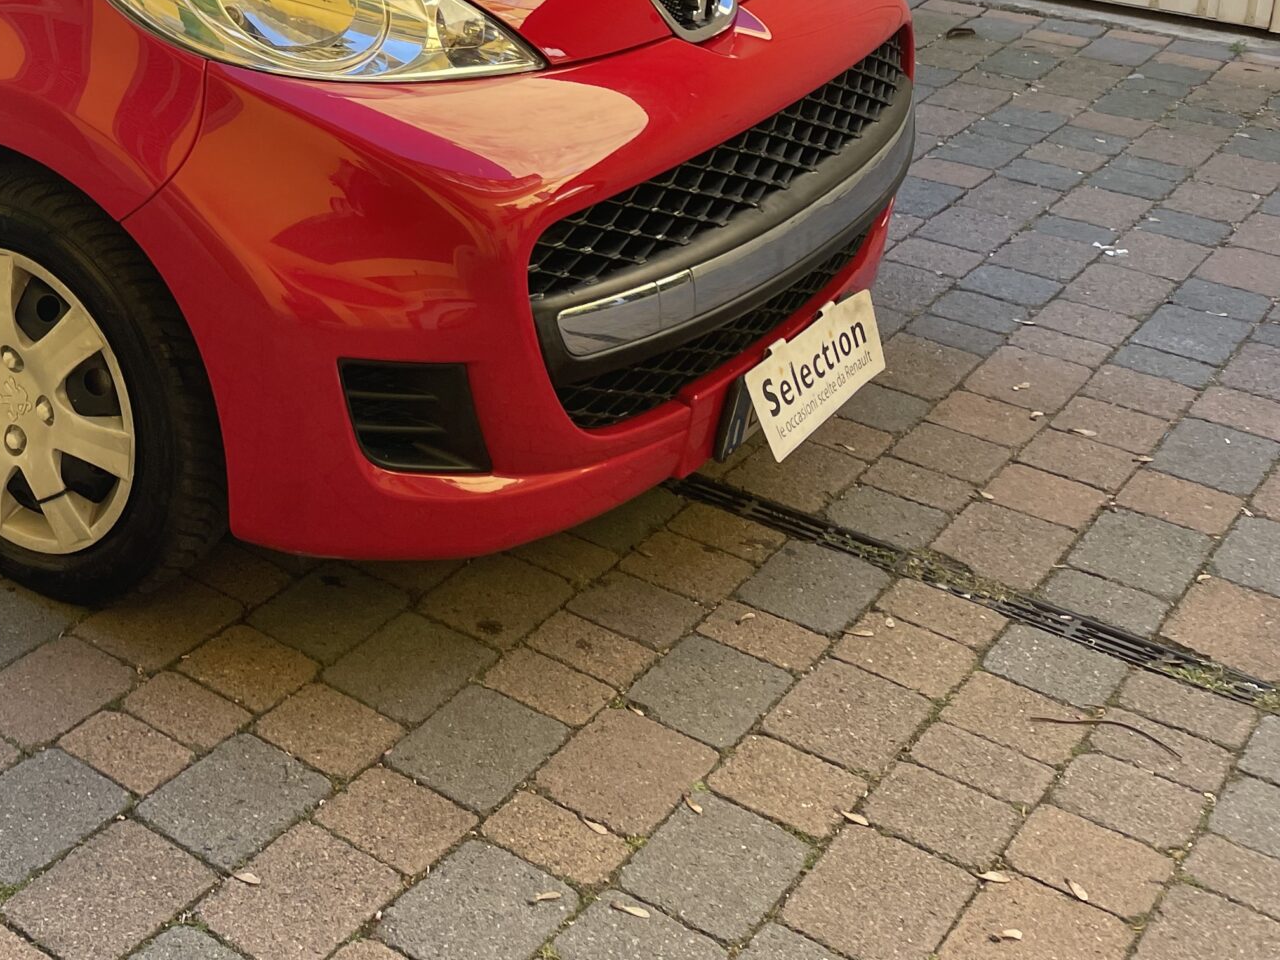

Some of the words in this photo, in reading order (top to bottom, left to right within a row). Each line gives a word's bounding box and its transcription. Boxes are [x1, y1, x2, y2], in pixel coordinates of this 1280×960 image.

[762, 321, 867, 417] Selection
[775, 423, 787, 439] le
[786, 400, 819, 432] occasioni
[817, 381, 837, 405] scelte
[836, 373, 847, 388] da
[844, 350, 873, 380] Renault
